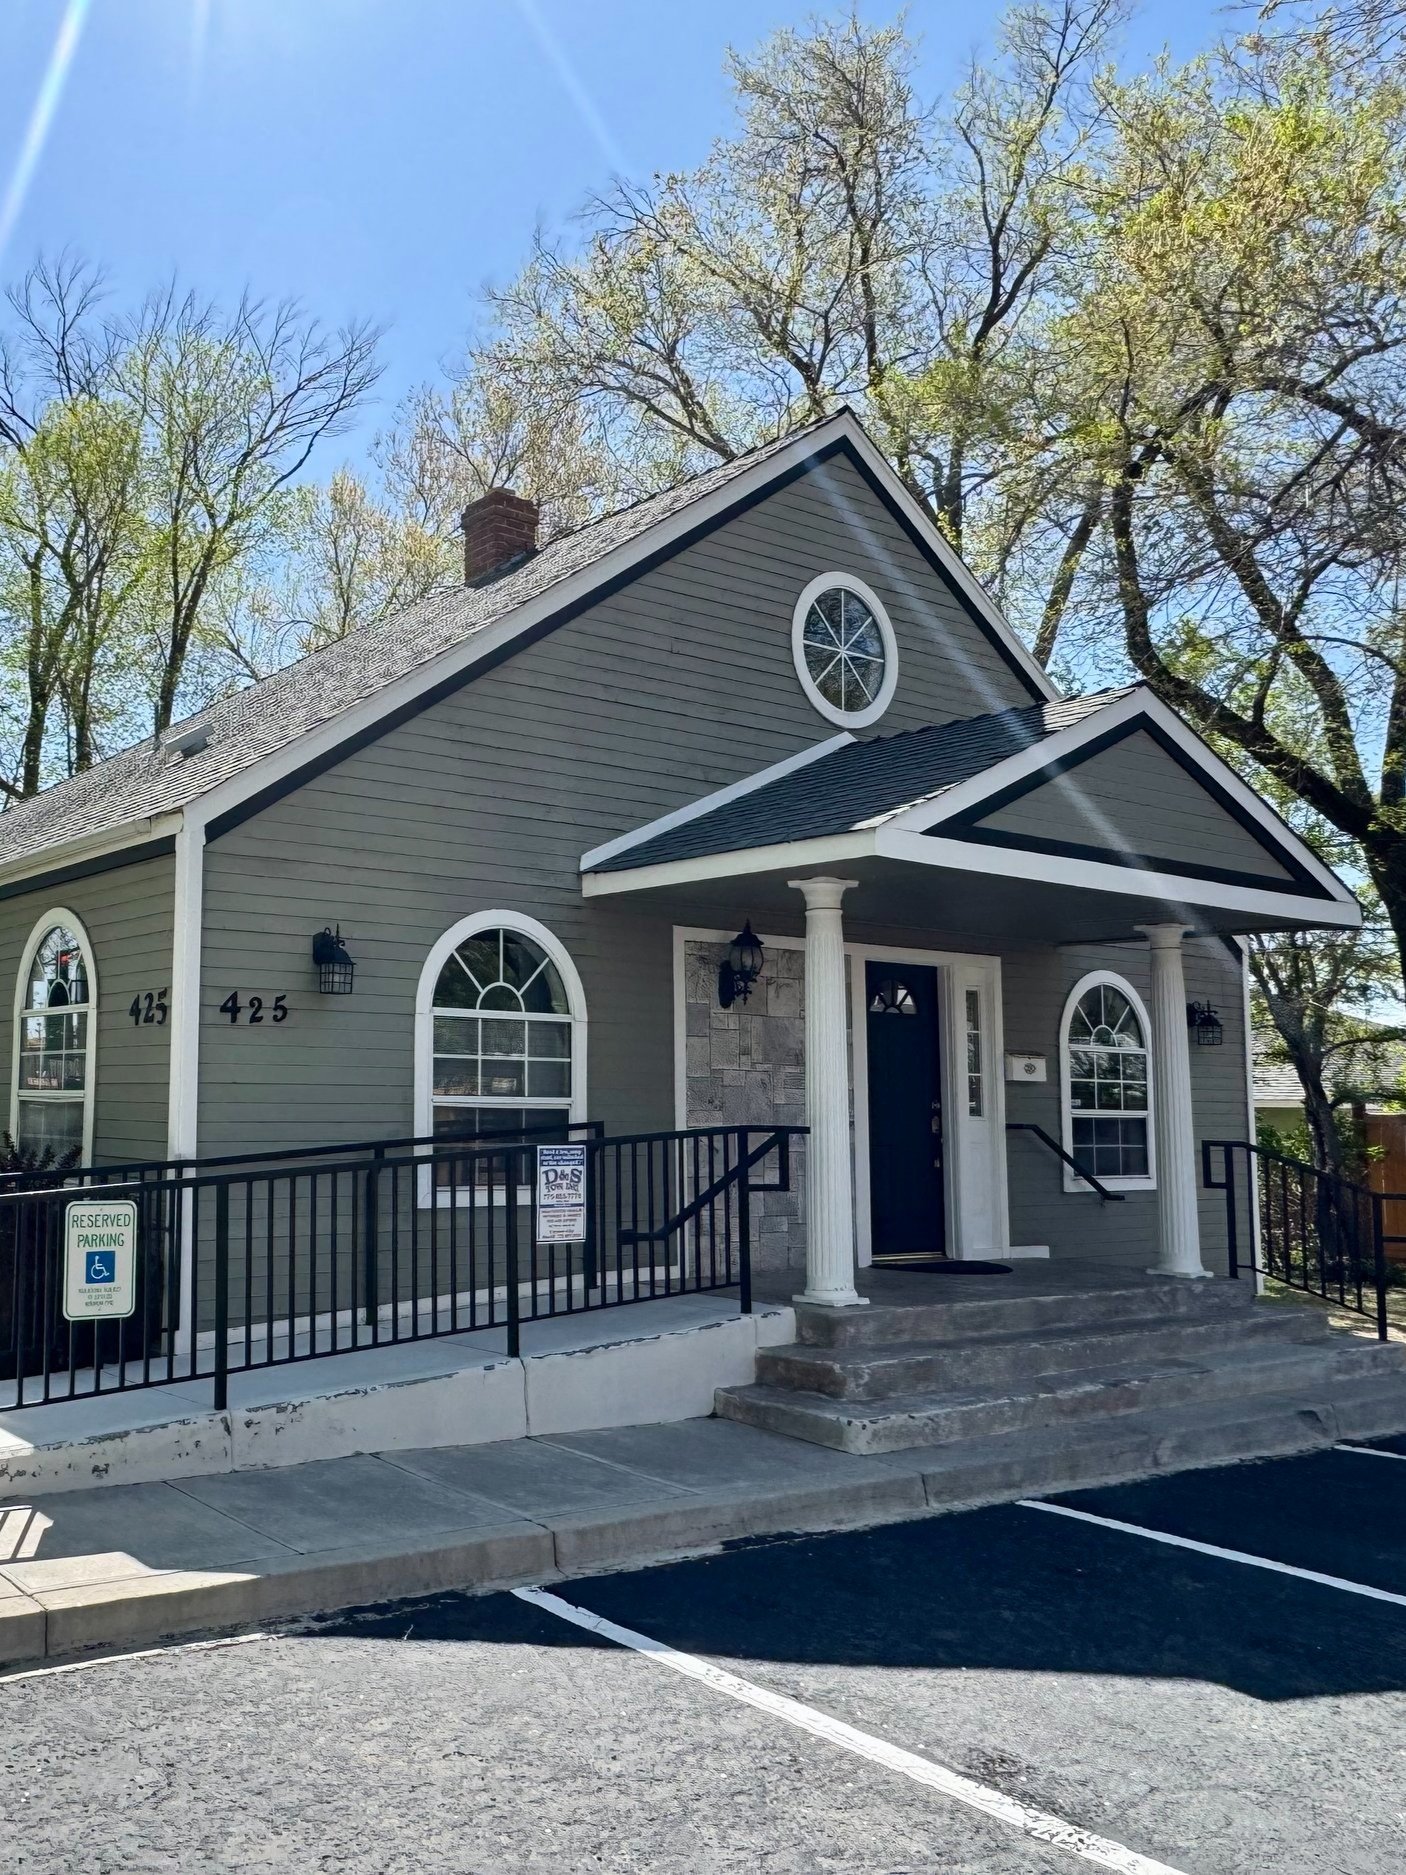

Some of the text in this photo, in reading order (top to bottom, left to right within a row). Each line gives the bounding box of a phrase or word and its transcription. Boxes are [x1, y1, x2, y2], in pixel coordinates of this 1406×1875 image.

[129, 987, 168, 1026] 425
[219, 990, 288, 1024] 425
[542, 1168, 583, 1185] D&S
[71, 1213, 131, 1229] RESERVED
[77, 1233, 125, 1248] PARKING
